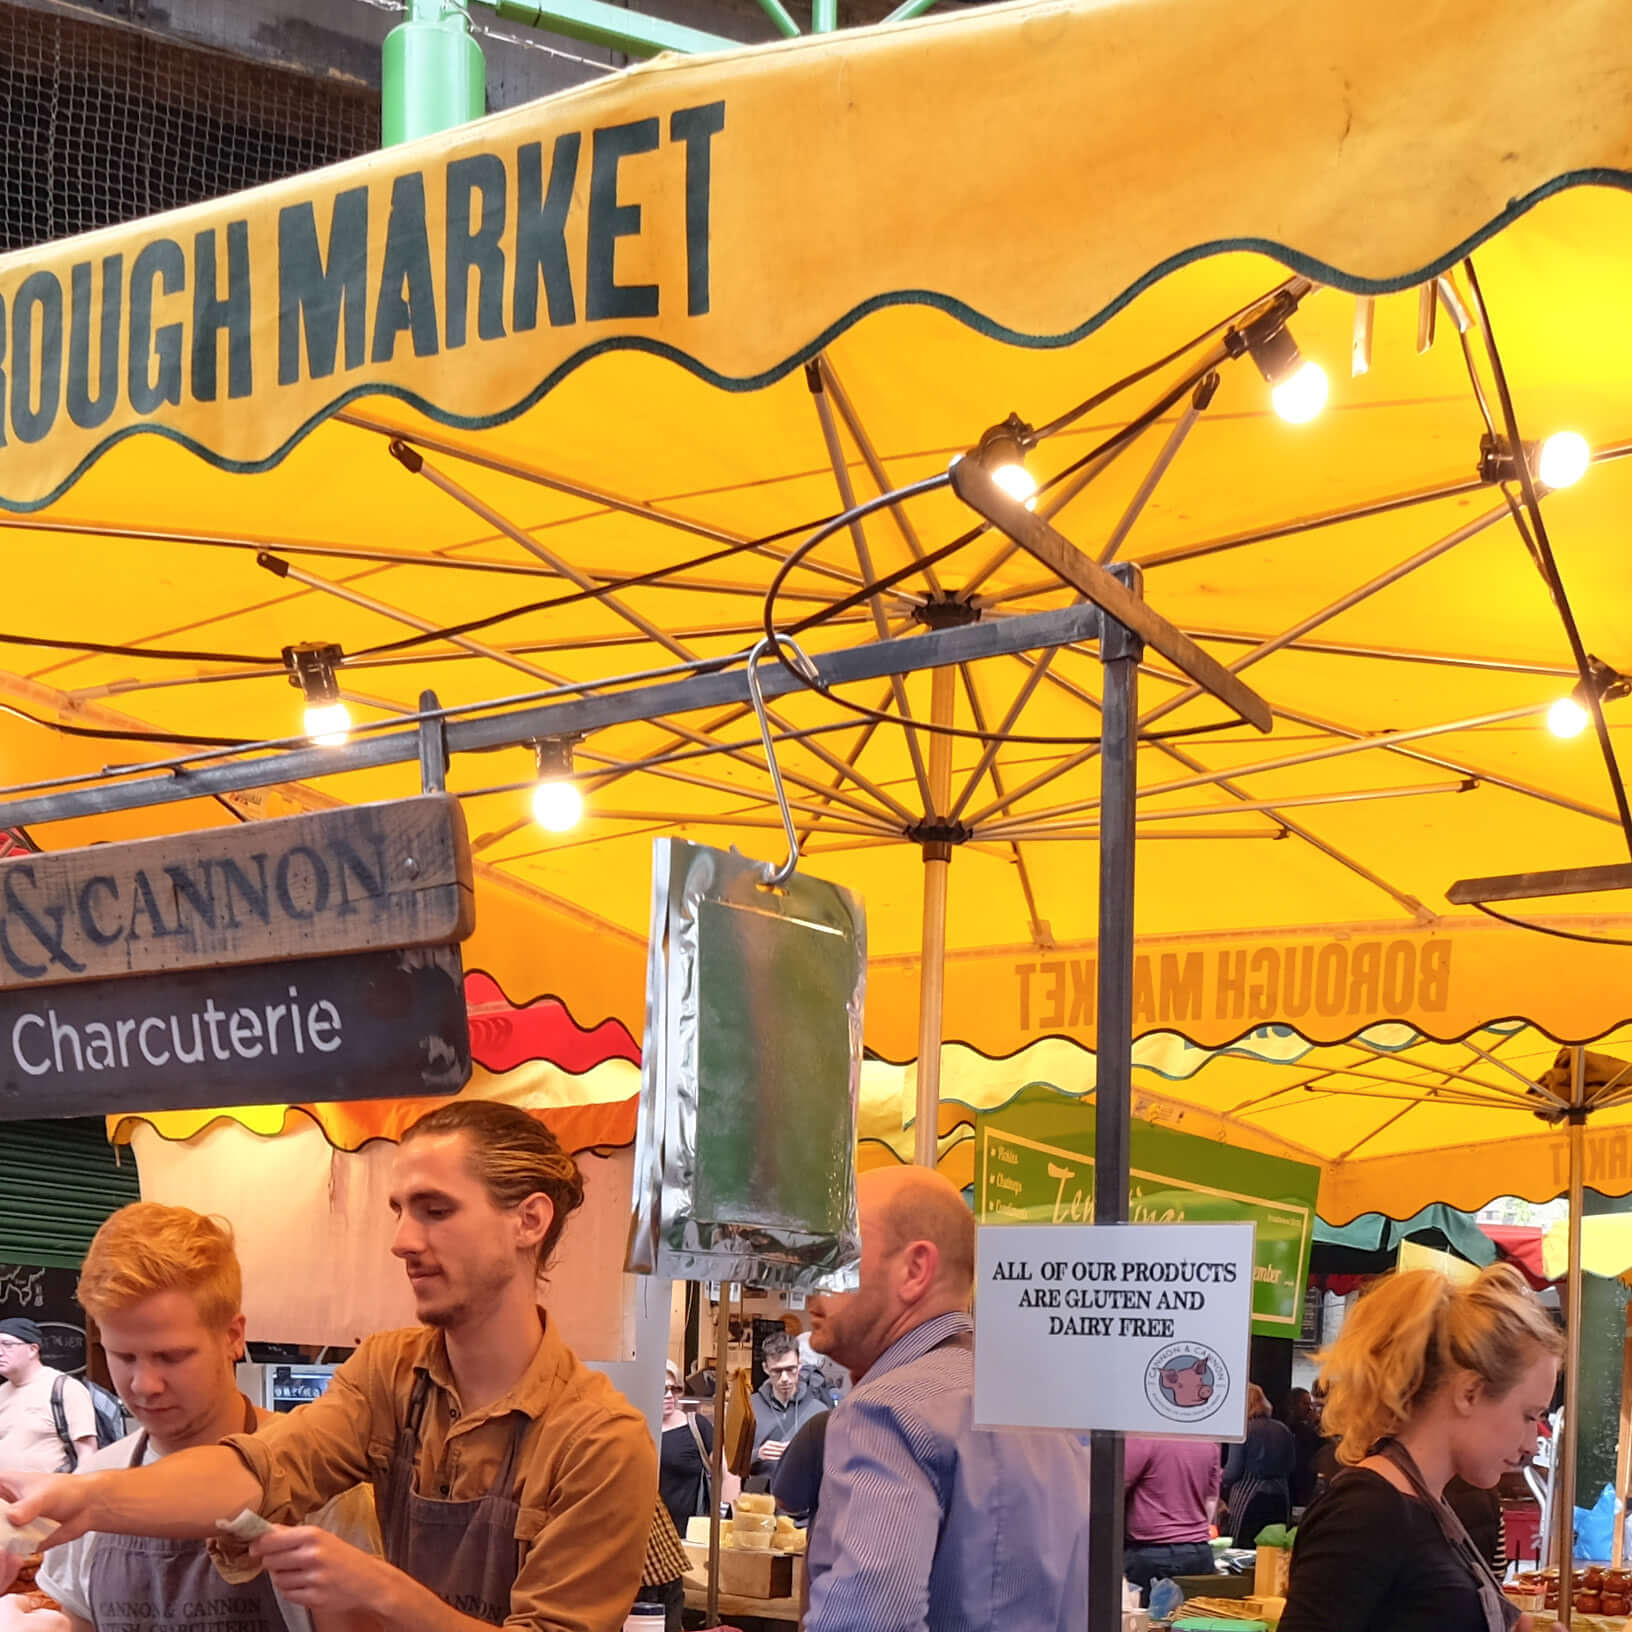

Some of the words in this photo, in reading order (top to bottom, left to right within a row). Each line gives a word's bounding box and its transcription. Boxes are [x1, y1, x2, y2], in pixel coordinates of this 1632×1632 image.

[277, 101, 726, 386] MARKET
[76, 834, 389, 948] CANNON
[12, 986, 343, 1076] Charcuterie
[992, 1261, 1032, 1281] ALL
[1040, 1261, 1068, 1281] OF
[1072, 1262, 1117, 1282] OUR
[1122, 1262, 1237, 1283] PRODUCTS
[1019, 1288, 1061, 1309] ARE
[1065, 1289, 1153, 1310] GLUTEN
[1156, 1290, 1206, 1311] AND
[1049, 1316, 1114, 1337] DAIRY
[1118, 1317, 1175, 1338] FREE
[182, 1597, 262, 1619] CANNON
